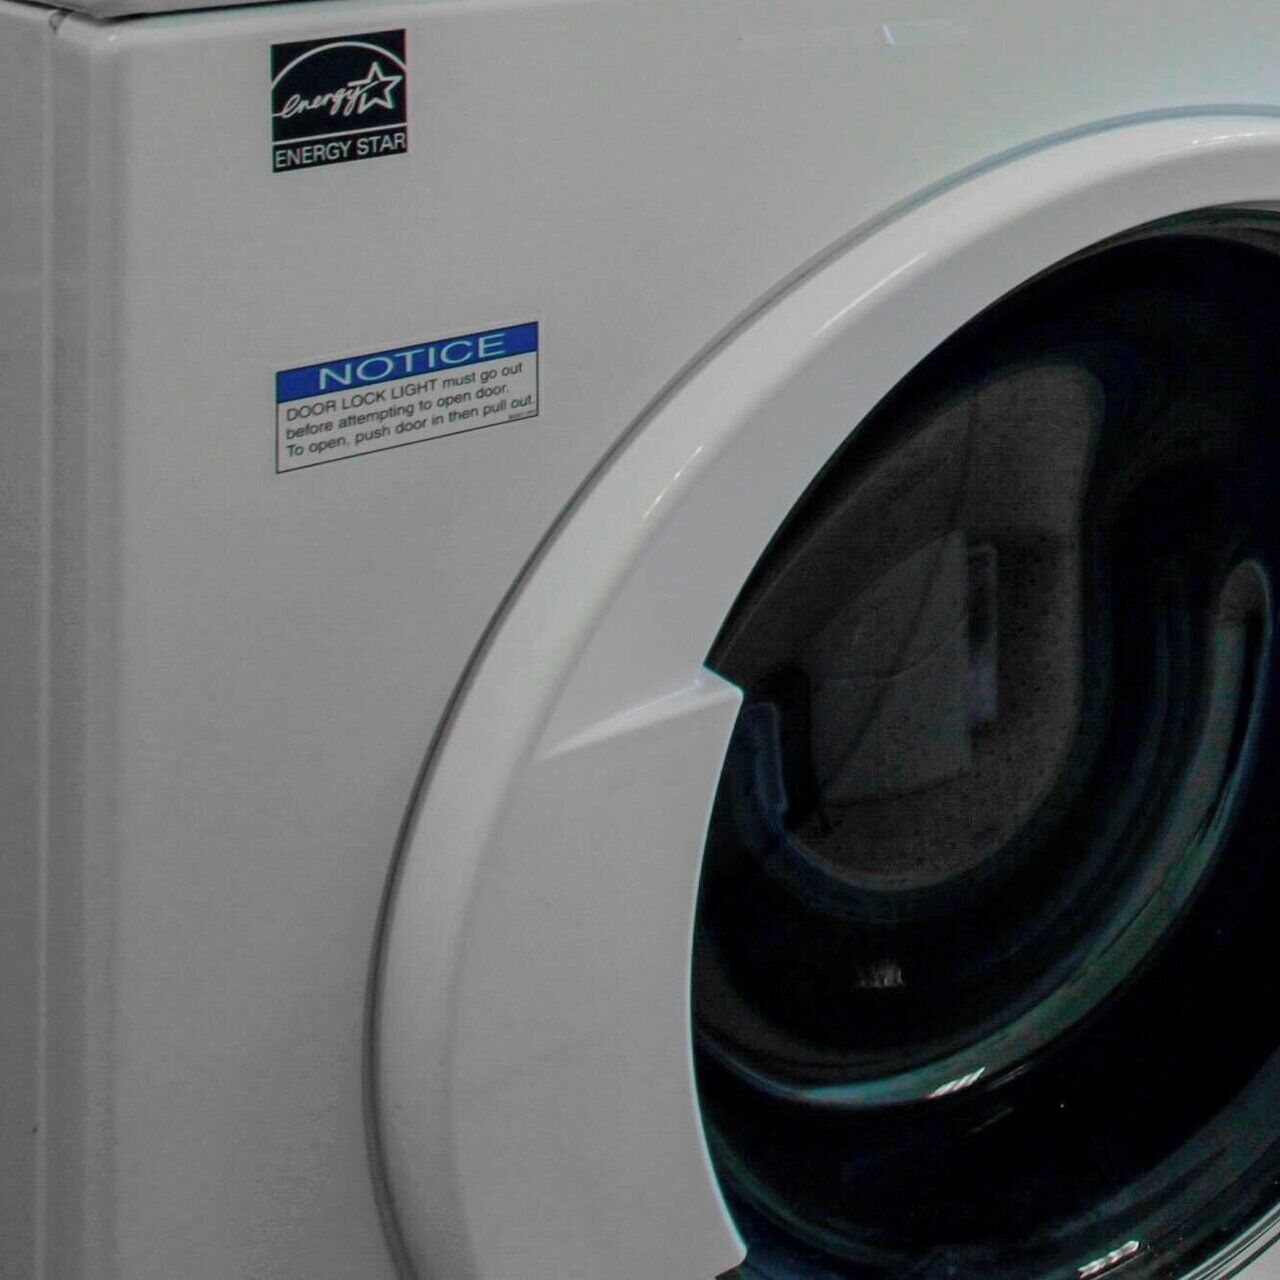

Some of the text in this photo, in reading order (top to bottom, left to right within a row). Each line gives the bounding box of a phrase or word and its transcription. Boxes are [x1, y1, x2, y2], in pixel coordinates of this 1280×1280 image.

[275, 133, 406, 168] ENERGY STAR
[319, 333, 506, 390] NOTICE
[286, 363, 522, 421] DOOR LOCK LIGHT must go out
[286, 420, 333, 440] before
[338, 404, 414, 429] attempting
[419, 399, 432, 411] to
[437, 391, 471, 408] open
[286, 444, 304, 458] To
[355, 425, 391, 446] push
[395, 419, 427, 434] door
[432, 415, 444, 426] in
[448, 407, 479, 423] then
[483, 400, 507, 417] pull
